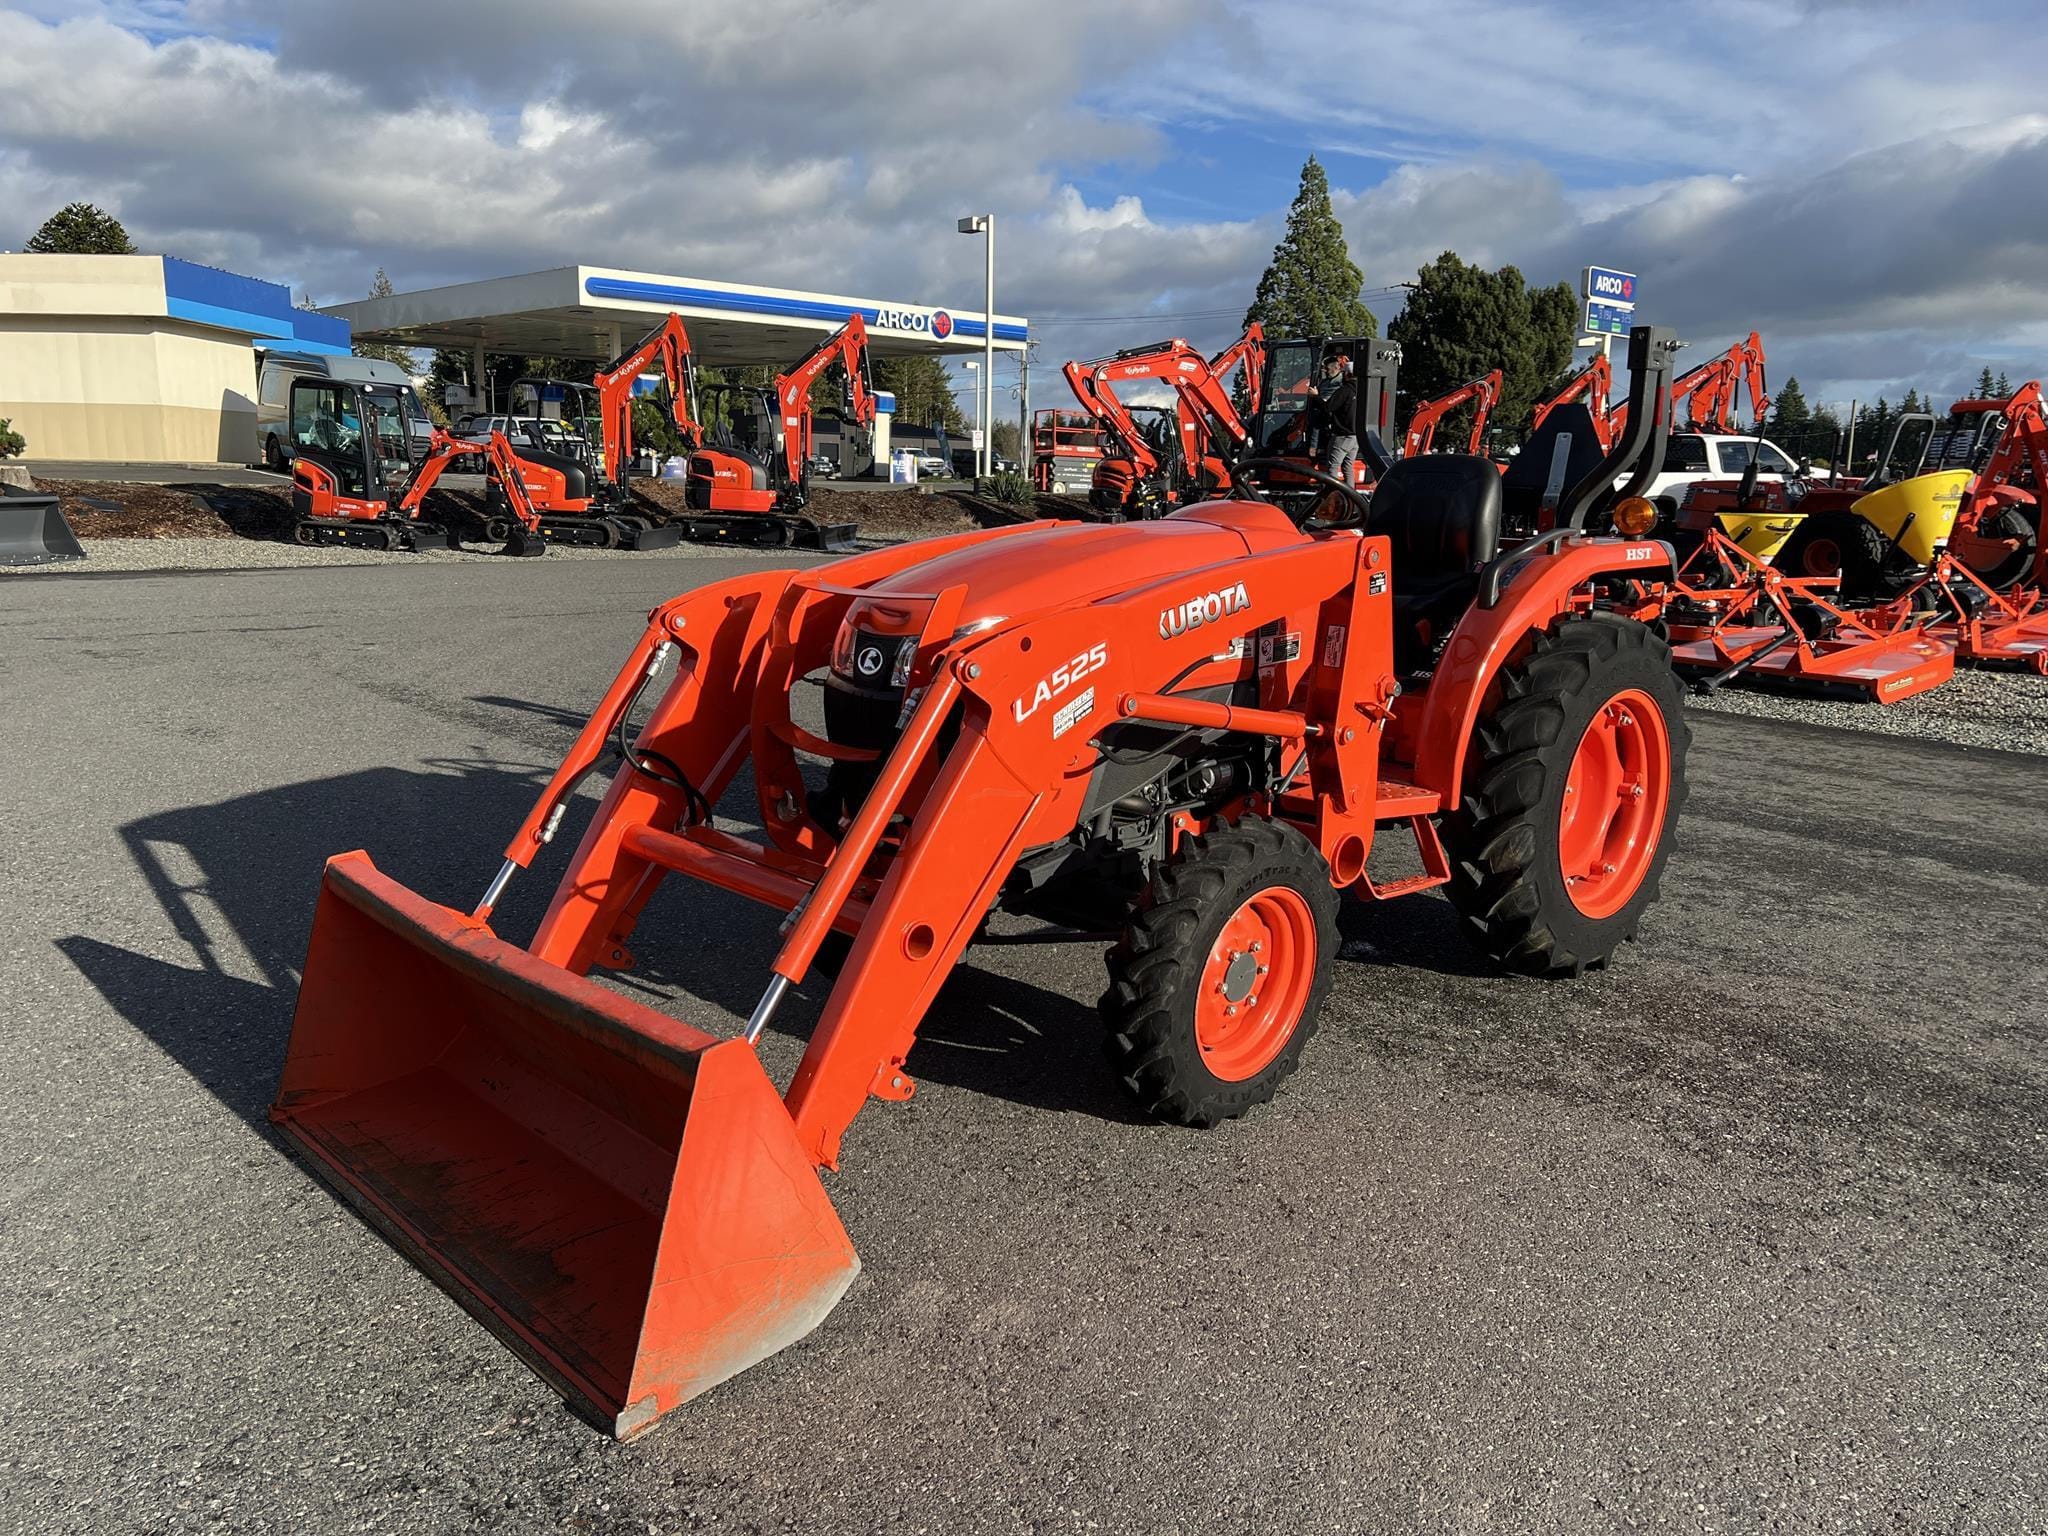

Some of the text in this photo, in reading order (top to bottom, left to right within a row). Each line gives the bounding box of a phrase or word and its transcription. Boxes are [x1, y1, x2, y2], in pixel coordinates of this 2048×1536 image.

[1595, 275, 1622, 295] ARCO
[875, 310, 925, 331] ARCO
[618, 356, 645, 376] Kubota
[806, 356, 828, 375] Kubota
[1124, 364, 1151, 375] Kubota
[1625, 546, 1653, 561] HST
[1158, 581, 1252, 641] KUBOTA
[1014, 641, 1108, 724] LA525
[1411, 669, 1433, 679] HS
